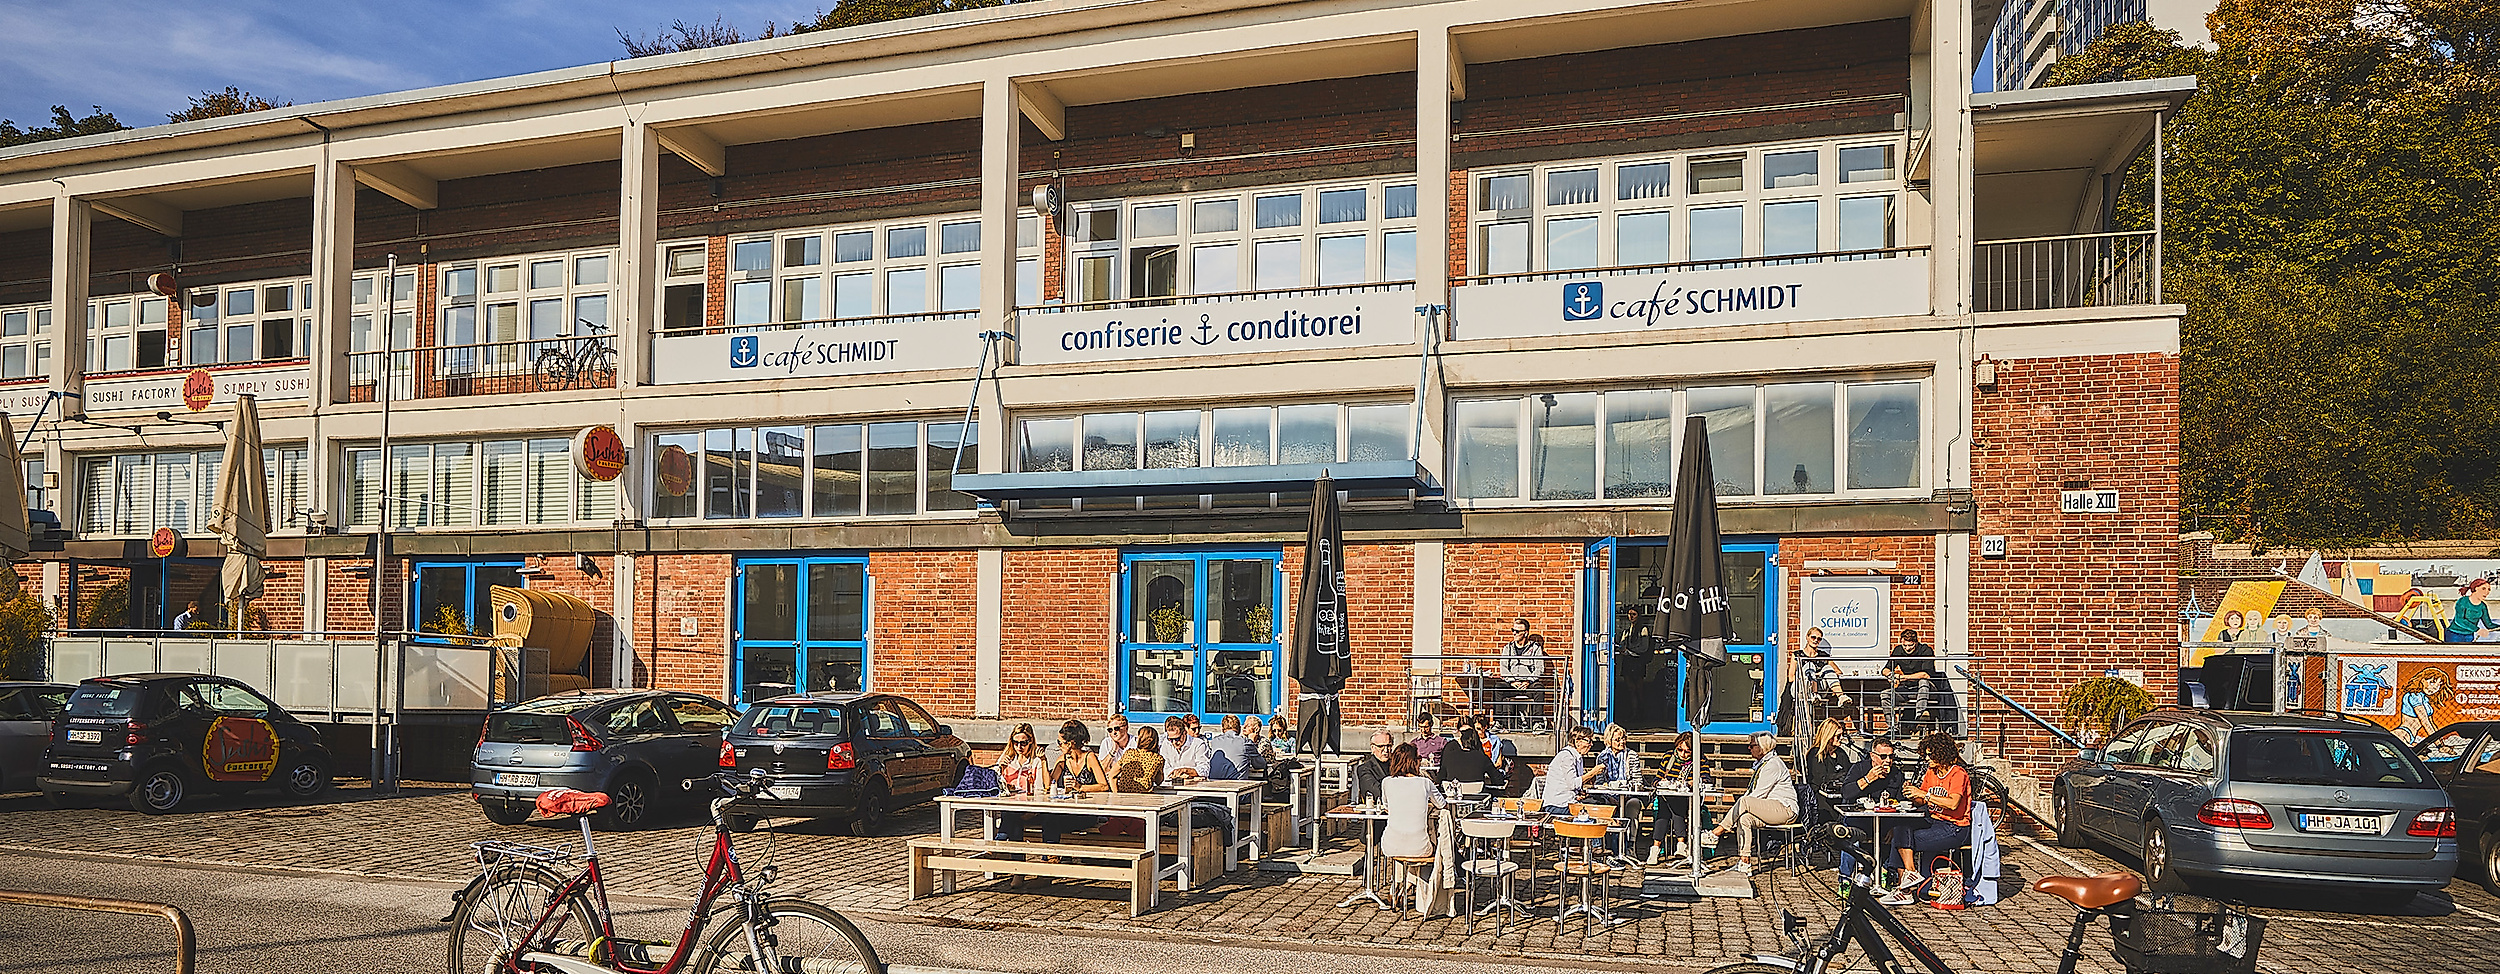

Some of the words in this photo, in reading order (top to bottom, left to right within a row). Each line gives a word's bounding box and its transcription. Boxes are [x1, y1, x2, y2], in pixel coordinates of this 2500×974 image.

[1610, 280, 1682, 327] café
[1686, 283, 1803, 315] SCHMIDT
[1061, 318, 1182, 351] confiserie
[1227, 306, 1362, 342] conditorei
[763, 334, 815, 374] café
[816, 339, 899, 365] SCHMIDT
[92, 390, 124, 403] SUSHI
[131, 386, 177, 401] FACTORY
[223, 381, 268, 395] SIMPLY
[585, 435, 621, 462] Sushi
[2063, 493, 2093, 509] Halle
[2095, 492, 2117, 508] XIII
[1984, 539, 2003, 552] 212
[1904, 575, 1919, 585] 212
[1831, 599, 1860, 616] café
[1820, 617, 1869, 629] SCHMIDT
[209, 724, 270, 767] Sushi
[2307, 815, 2325, 828] HH
[2334, 817, 2351, 829] JA
[2354, 818, 2379, 830] 101
